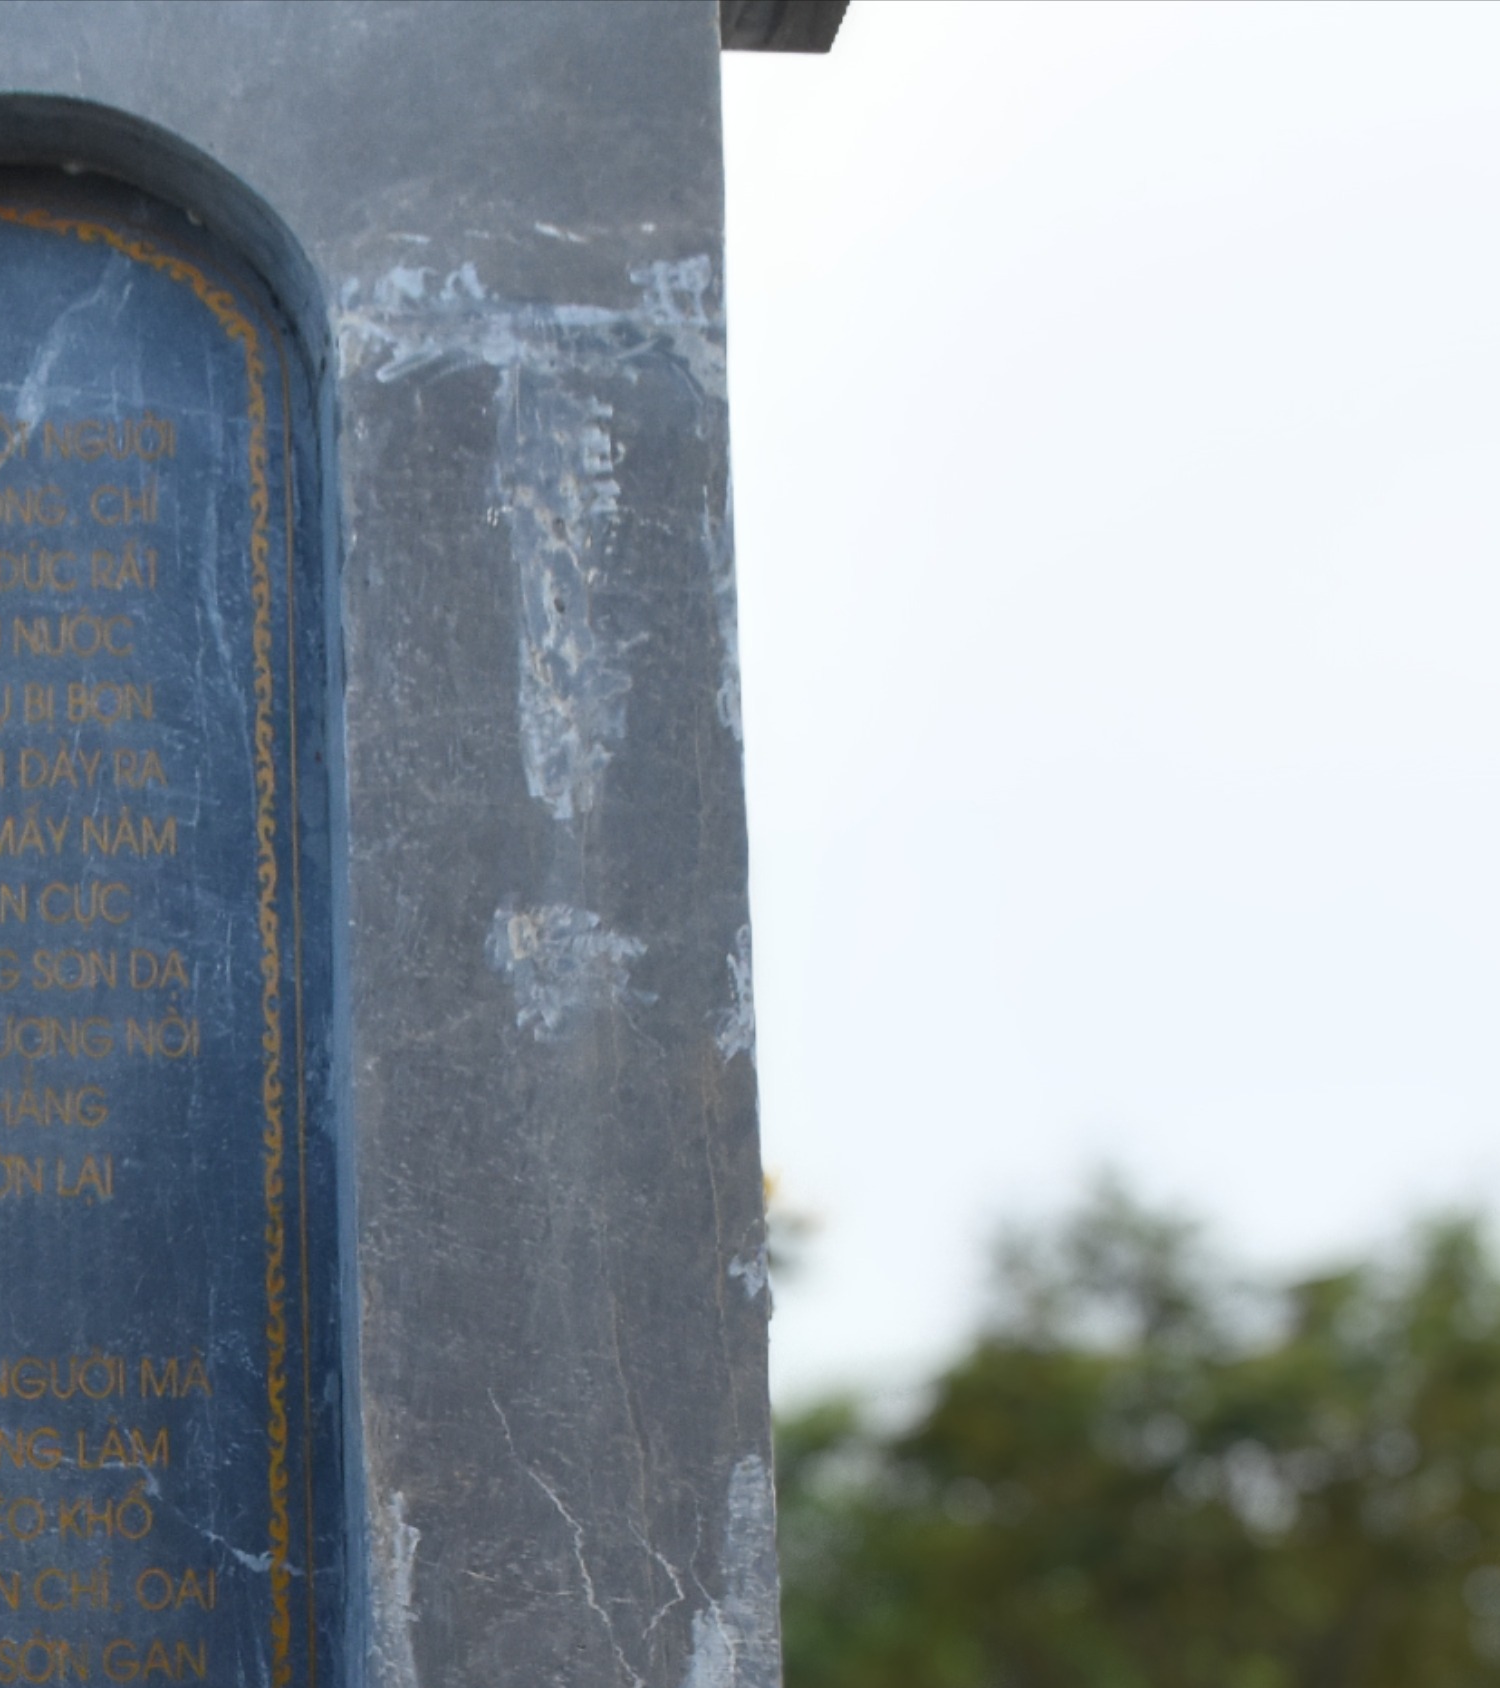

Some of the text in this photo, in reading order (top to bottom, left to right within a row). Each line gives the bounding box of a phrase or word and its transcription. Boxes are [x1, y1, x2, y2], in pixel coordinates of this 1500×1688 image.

[44, 409, 177, 462] NGƯỜI
[89, 475, 158, 526] CHÍ
[91, 539, 158, 591] RẤT
[12, 608, 134, 659] NƯỚC
[24, 683, 53, 730] BỊ
[68, 683, 155, 729] BỌN
[18, 741, 101, 790] ĐÀY
[113, 749, 168, 789] RA
[81, 805, 178, 856] NĂM
[40, 881, 131, 931] CỰC
[129, 949, 190, 999] DẠ
[125, 1007, 201, 1060] NÒI
[56, 1154, 114, 1206] LẠI
[140, 1346, 213, 1398] MÀ
[77, 1416, 171, 1470] LÀM
[135, 1568, 217, 1612] OAI
[102, 1639, 208, 1684] GAN
